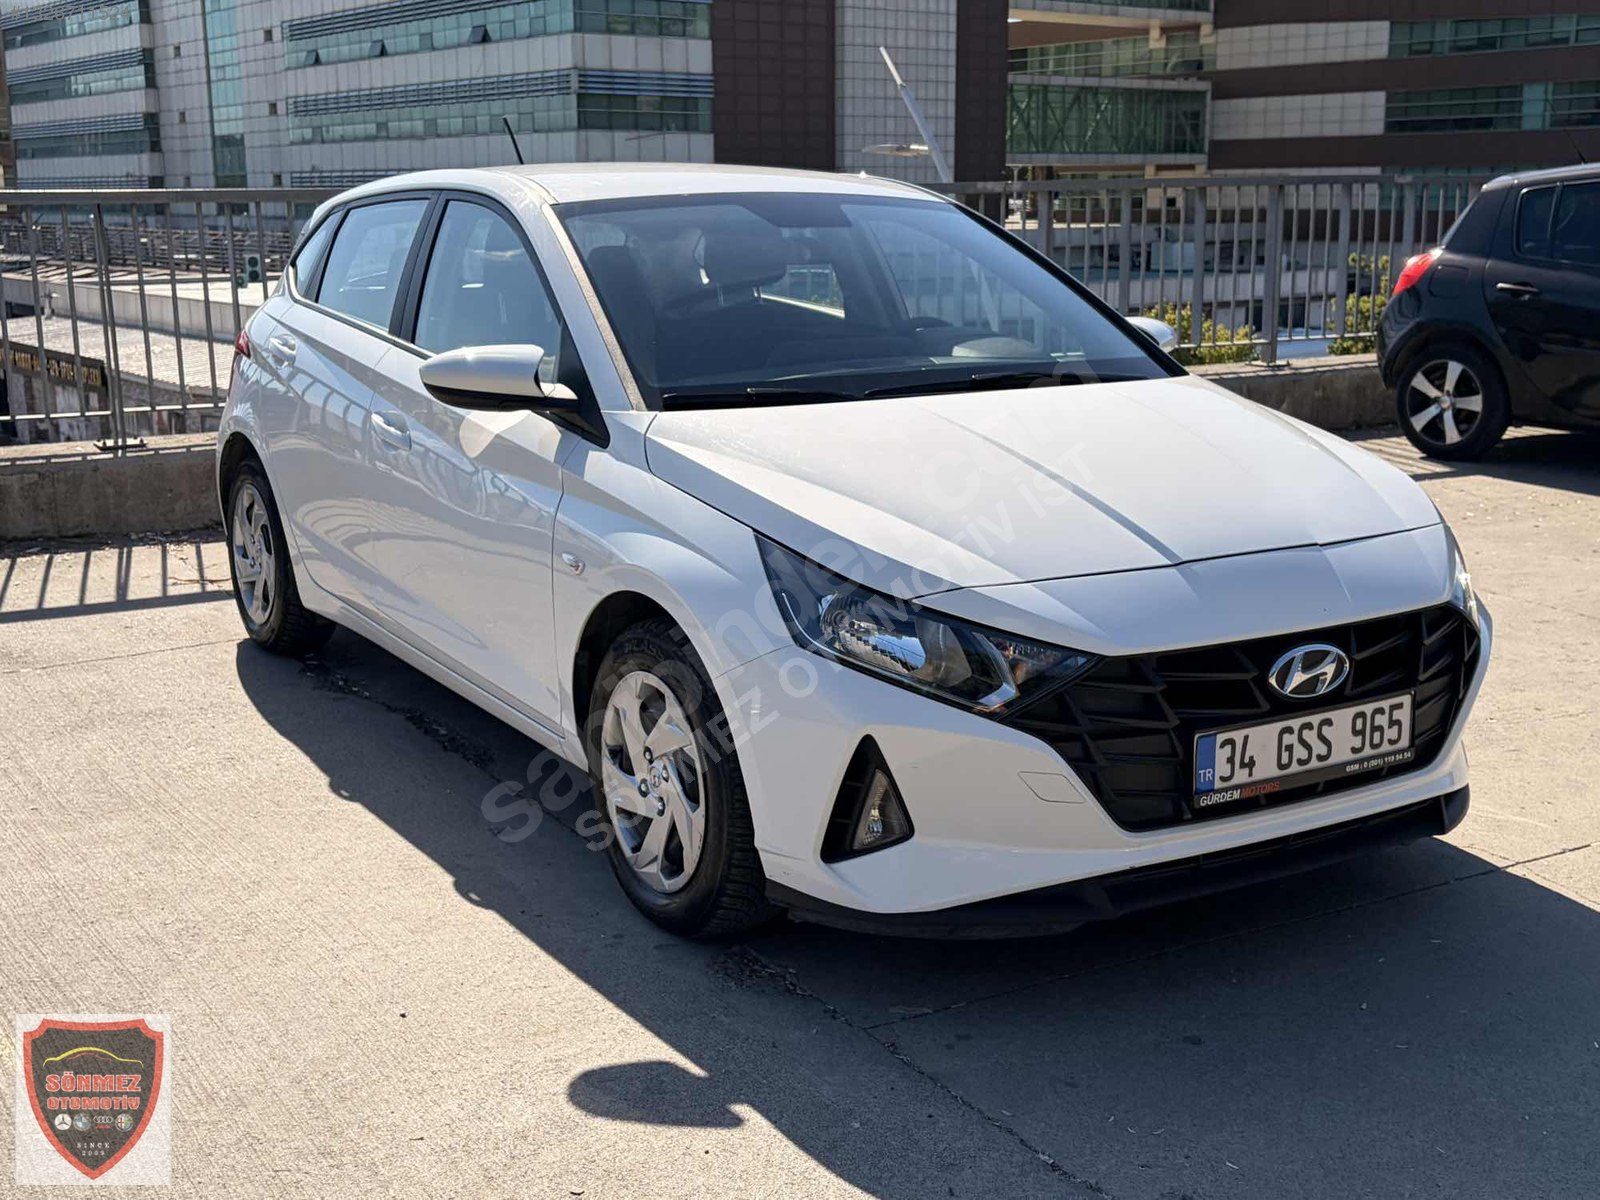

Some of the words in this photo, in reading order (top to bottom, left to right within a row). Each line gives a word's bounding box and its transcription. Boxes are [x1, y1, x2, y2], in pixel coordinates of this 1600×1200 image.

[1218, 734, 1256, 783] 34
[1276, 717, 1333, 771] GSS
[1350, 702, 1404, 755] 965
[1198, 768, 1213, 783] TR
